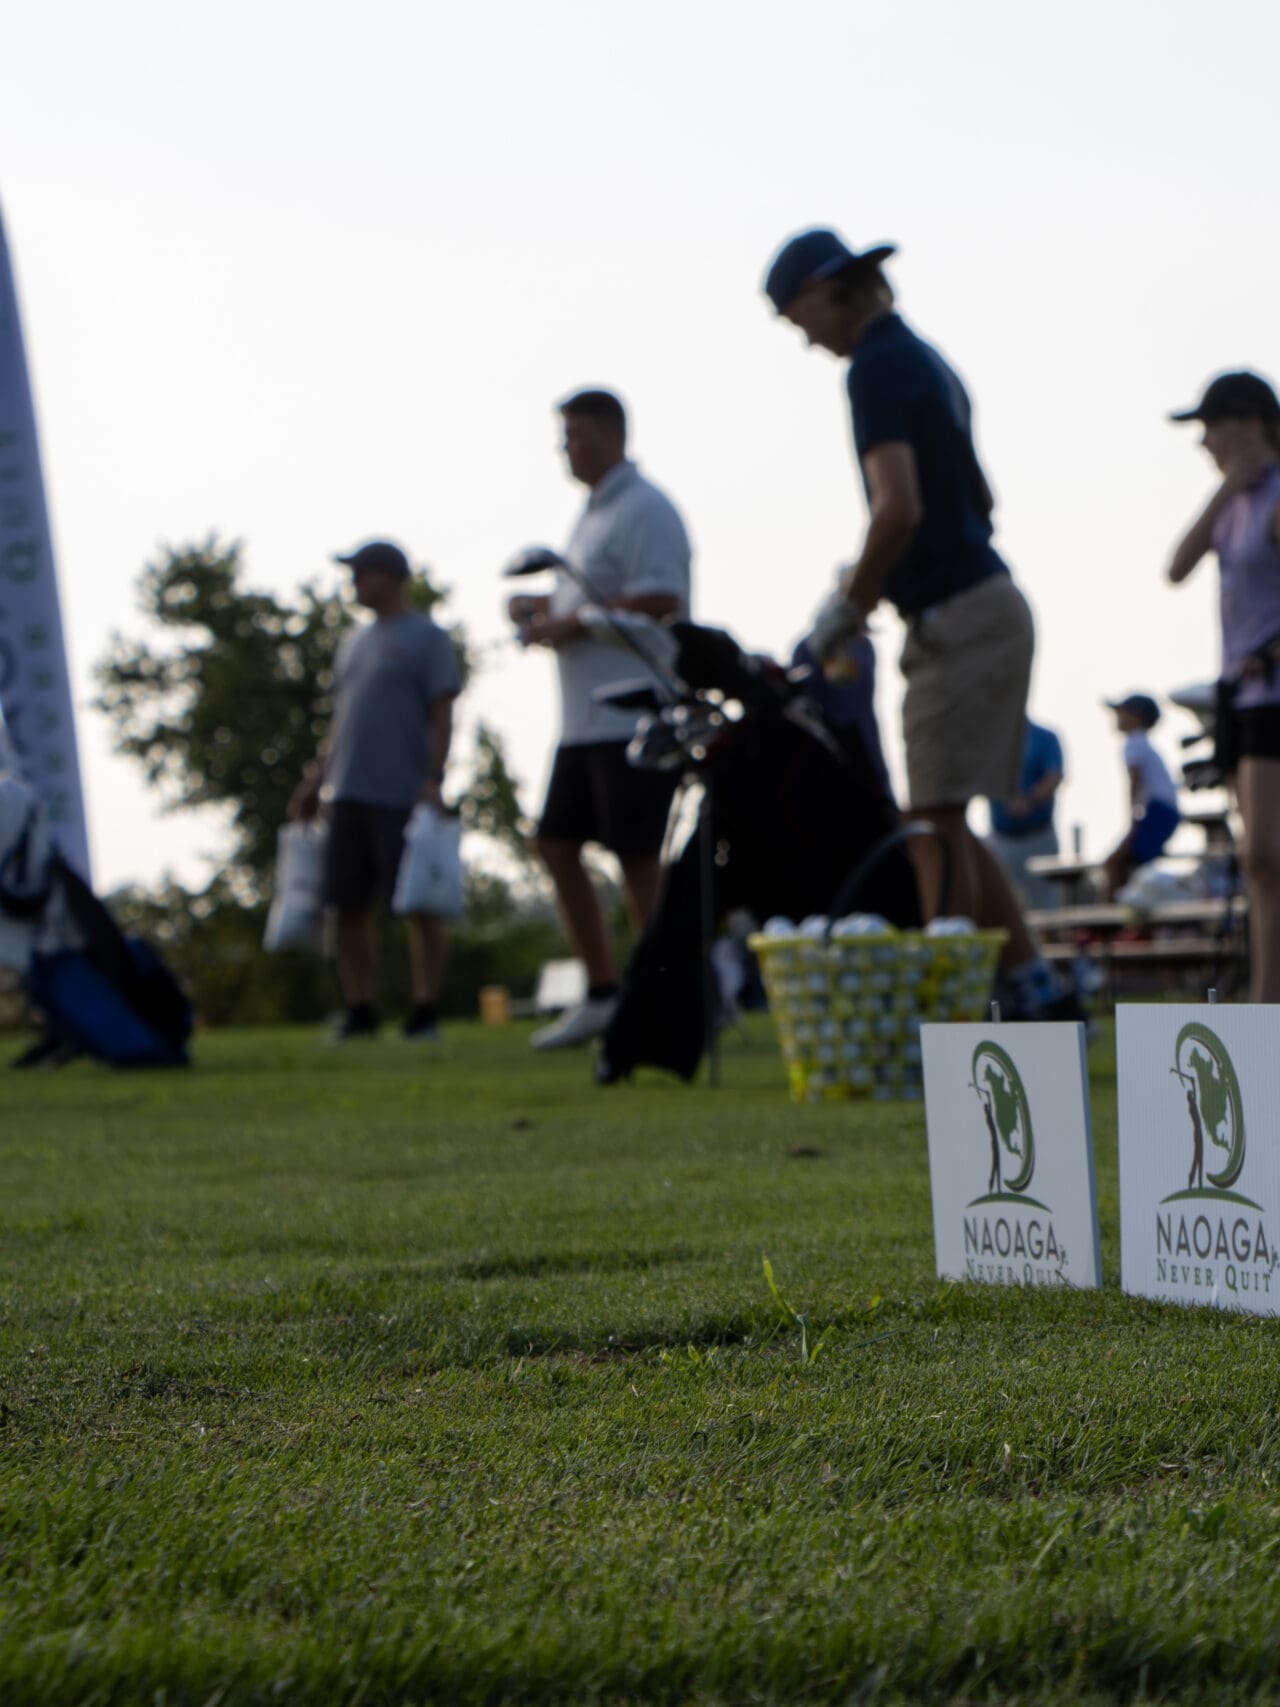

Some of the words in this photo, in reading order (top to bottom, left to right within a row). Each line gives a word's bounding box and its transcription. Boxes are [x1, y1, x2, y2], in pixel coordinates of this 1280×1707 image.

[963, 1216, 1060, 1262] NAOAGA
[1156, 1212, 1270, 1264] NAOAGA
[1156, 1257, 1214, 1287] NEVER
[1225, 1264, 1271, 1297] QUIT
